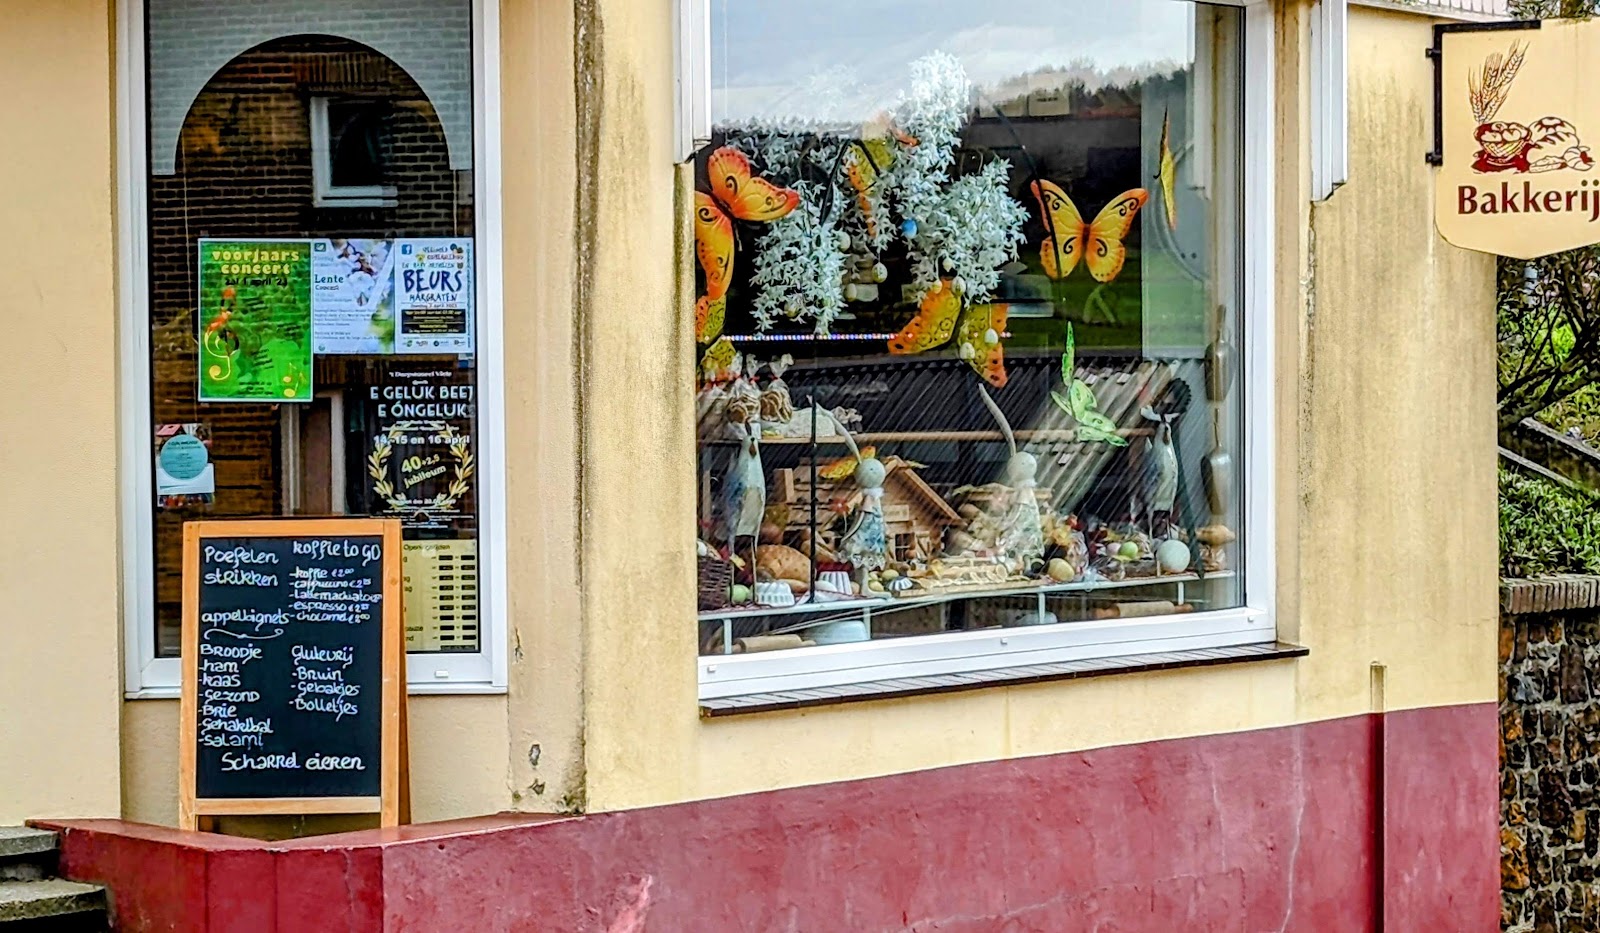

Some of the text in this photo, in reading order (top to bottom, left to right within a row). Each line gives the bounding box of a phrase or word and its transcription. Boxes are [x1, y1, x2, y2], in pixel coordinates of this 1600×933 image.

[1458, 179, 1600, 222] Bakkerij
[212, 249, 299, 263] voorjaars
[221, 263, 290, 275] concert
[314, 274, 344, 284] Lente
[403, 269, 462, 293] BEURS
[370, 386, 474, 402] E GELUK BEEJ
[378, 403, 387, 417] E
[410, 436, 425, 444] en
[428, 435, 442, 444] 16
[444, 434, 470, 446] april
[343, 539, 359, 558] to
